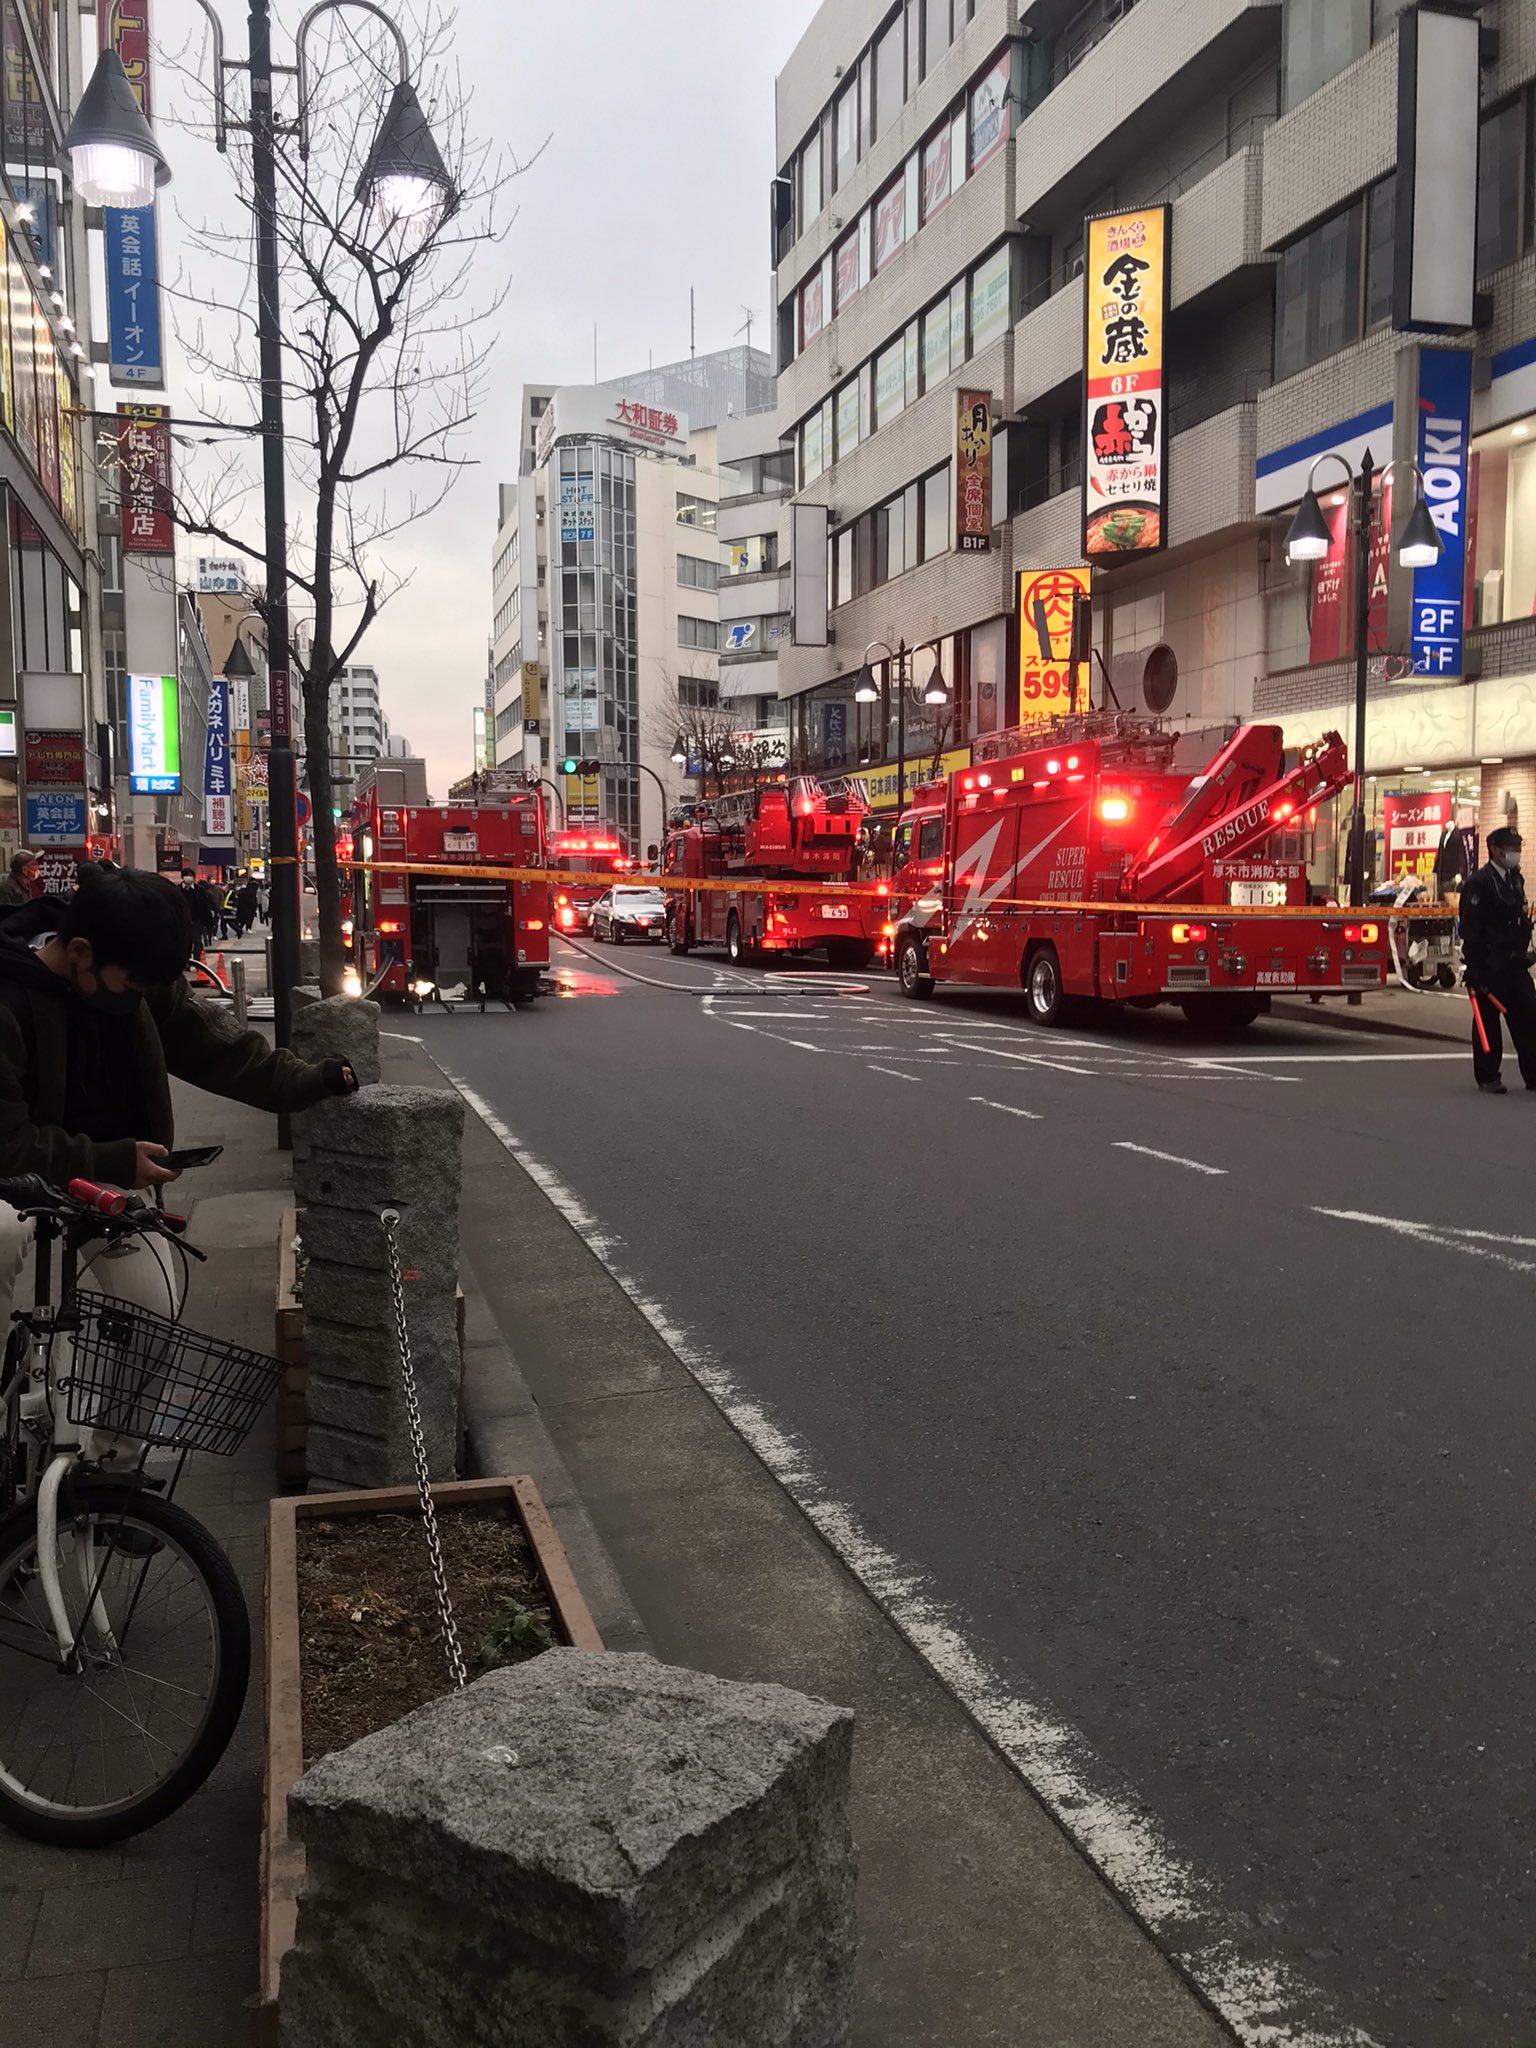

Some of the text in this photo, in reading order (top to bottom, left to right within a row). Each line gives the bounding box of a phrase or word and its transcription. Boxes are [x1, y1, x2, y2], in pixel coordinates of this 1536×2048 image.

[1107, 221, 1145, 238] きんくら
[1103, 254, 1150, 365] 金の蔵
[126, 369, 147, 378] 4F
[1111, 374, 1139, 394] 6F
[616, 399, 678, 436] 大和証券
[962, 403, 987, 468] 月あかり
[1106, 464, 1157, 482] 赤から鍋
[1423, 417, 1463, 537] AOKI
[566, 486, 587, 494] HOT
[1106, 479, 1157, 496] セセリ焼
[562, 494, 593, 503] STAFF
[965, 472, 983, 532] 全席個室
[963, 537, 985, 549] B1F
[1317, 578, 1340, 594] 値下げ
[1420, 608, 1454, 635] 2F
[1424, 647, 1453, 671] 1F
[138, 679, 156, 769] FamilyMart
[37, 794, 75, 804] AEON
[37, 807, 76, 820] 英会話
[212, 797, 226, 833] 補聴器
[1391, 805, 1441, 823] シーズン商品
[33, 820, 80, 832] イーオン
[1201, 800, 1270, 858] RESCUE
[1405, 831, 1426, 846] 最終
[1055, 846, 1085, 866] SUPER
[1047, 868, 1084, 888] RESCUE
[1213, 864, 1300, 879] 厚木市消防本部
